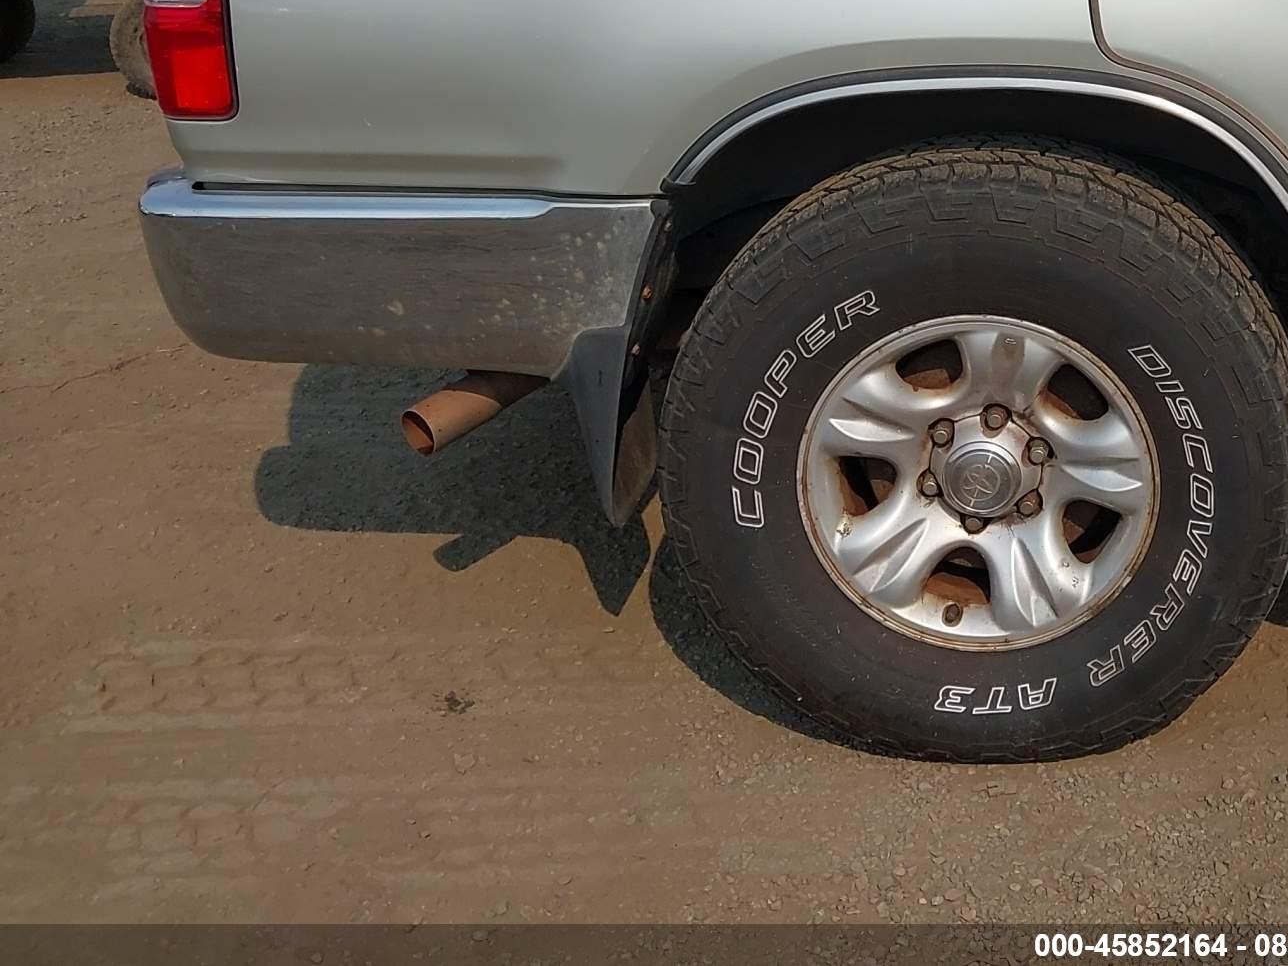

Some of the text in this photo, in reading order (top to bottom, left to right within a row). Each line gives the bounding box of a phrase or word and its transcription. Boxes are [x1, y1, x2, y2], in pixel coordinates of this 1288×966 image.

[732, 290, 880, 528] COOPER
[934, 345, 1214, 715] DISCOVERER AT3
